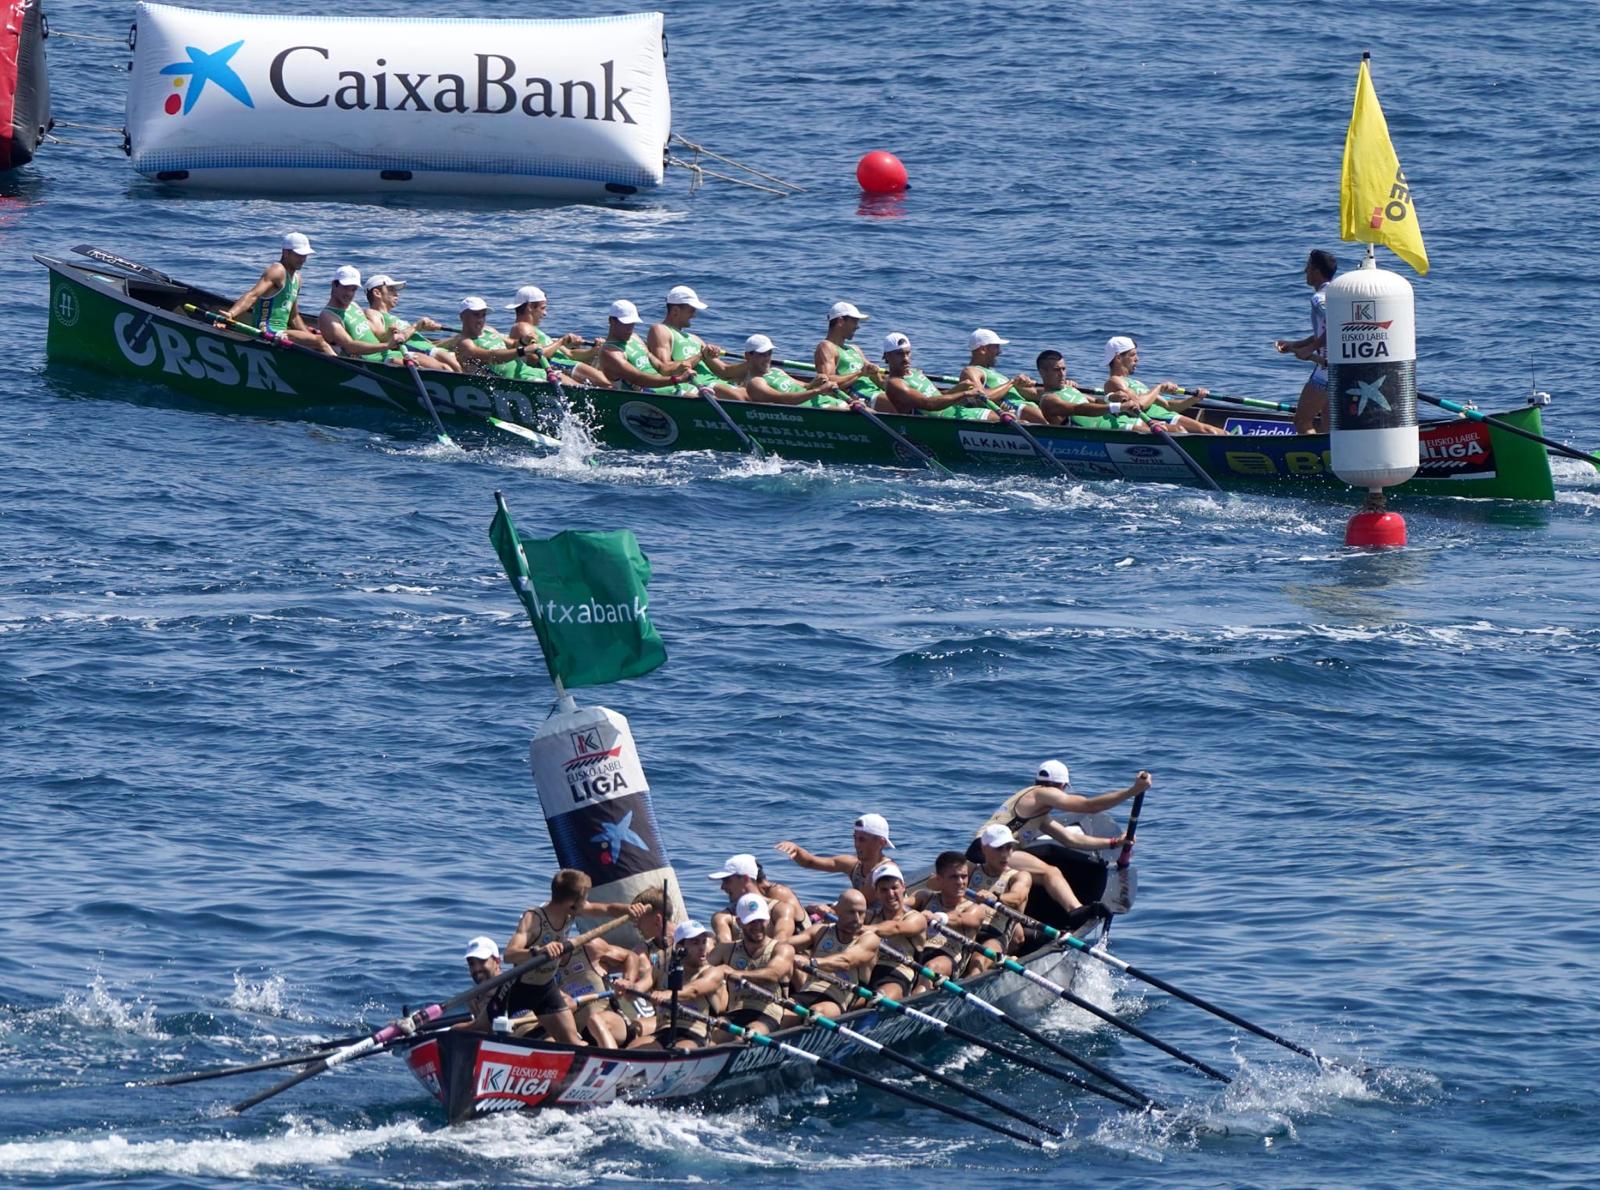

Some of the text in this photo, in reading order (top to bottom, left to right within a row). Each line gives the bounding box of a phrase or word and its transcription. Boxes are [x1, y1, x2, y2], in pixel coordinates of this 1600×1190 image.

[268, 45, 638, 125] CaixaBank
[1341, 332, 1389, 341] EUSKO LABEL
[1342, 341, 1389, 359] LIGA
[962, 436, 1017, 450] ALKAIN
[1426, 432, 1481, 448] EUSKO LABEL
[1428, 441, 1484, 458] LIGA
[567, 760, 624, 784] EUSKO LABEL
[570, 772, 628, 803] LIGA
[511, 1065, 560, 1079] EUSKO LABEL
[503, 1077, 552, 1096] LIGA
